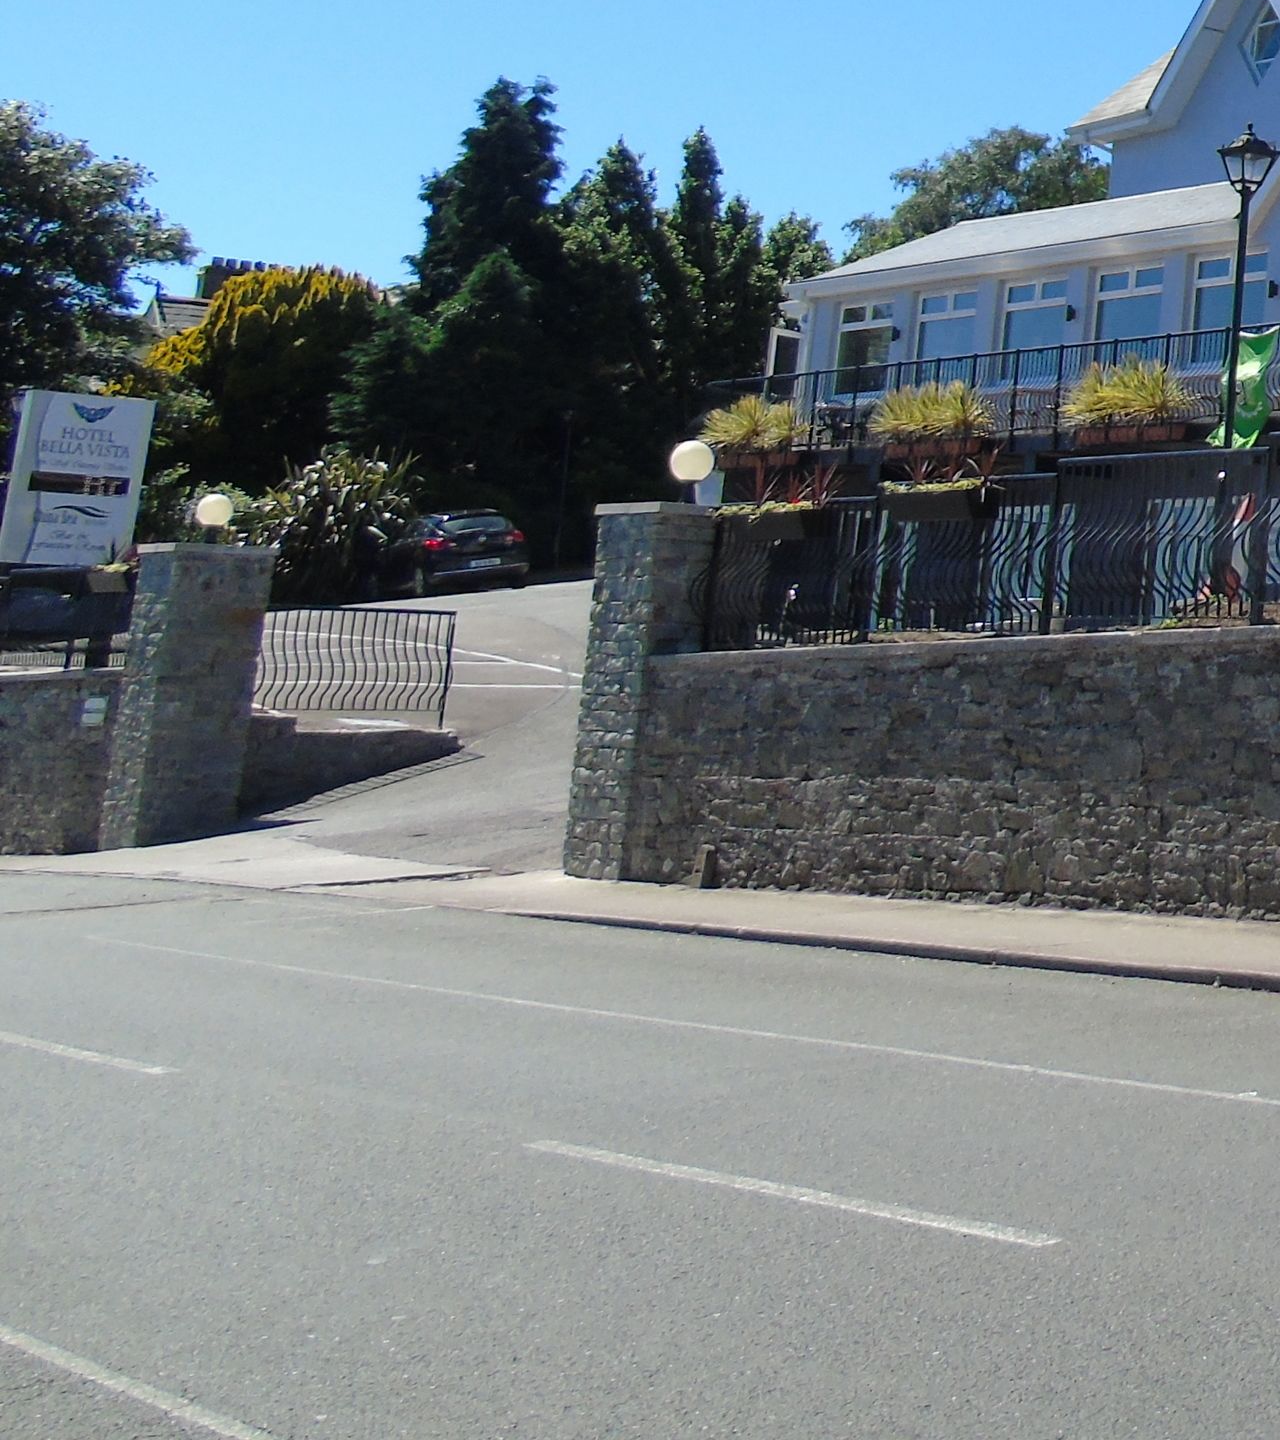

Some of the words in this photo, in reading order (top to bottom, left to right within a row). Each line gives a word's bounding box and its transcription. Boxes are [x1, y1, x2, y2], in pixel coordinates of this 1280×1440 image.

[61, 426, 114, 443] HOTEL
[40, 440, 83, 455] BELLA
[87, 443, 130, 458] VISTA
